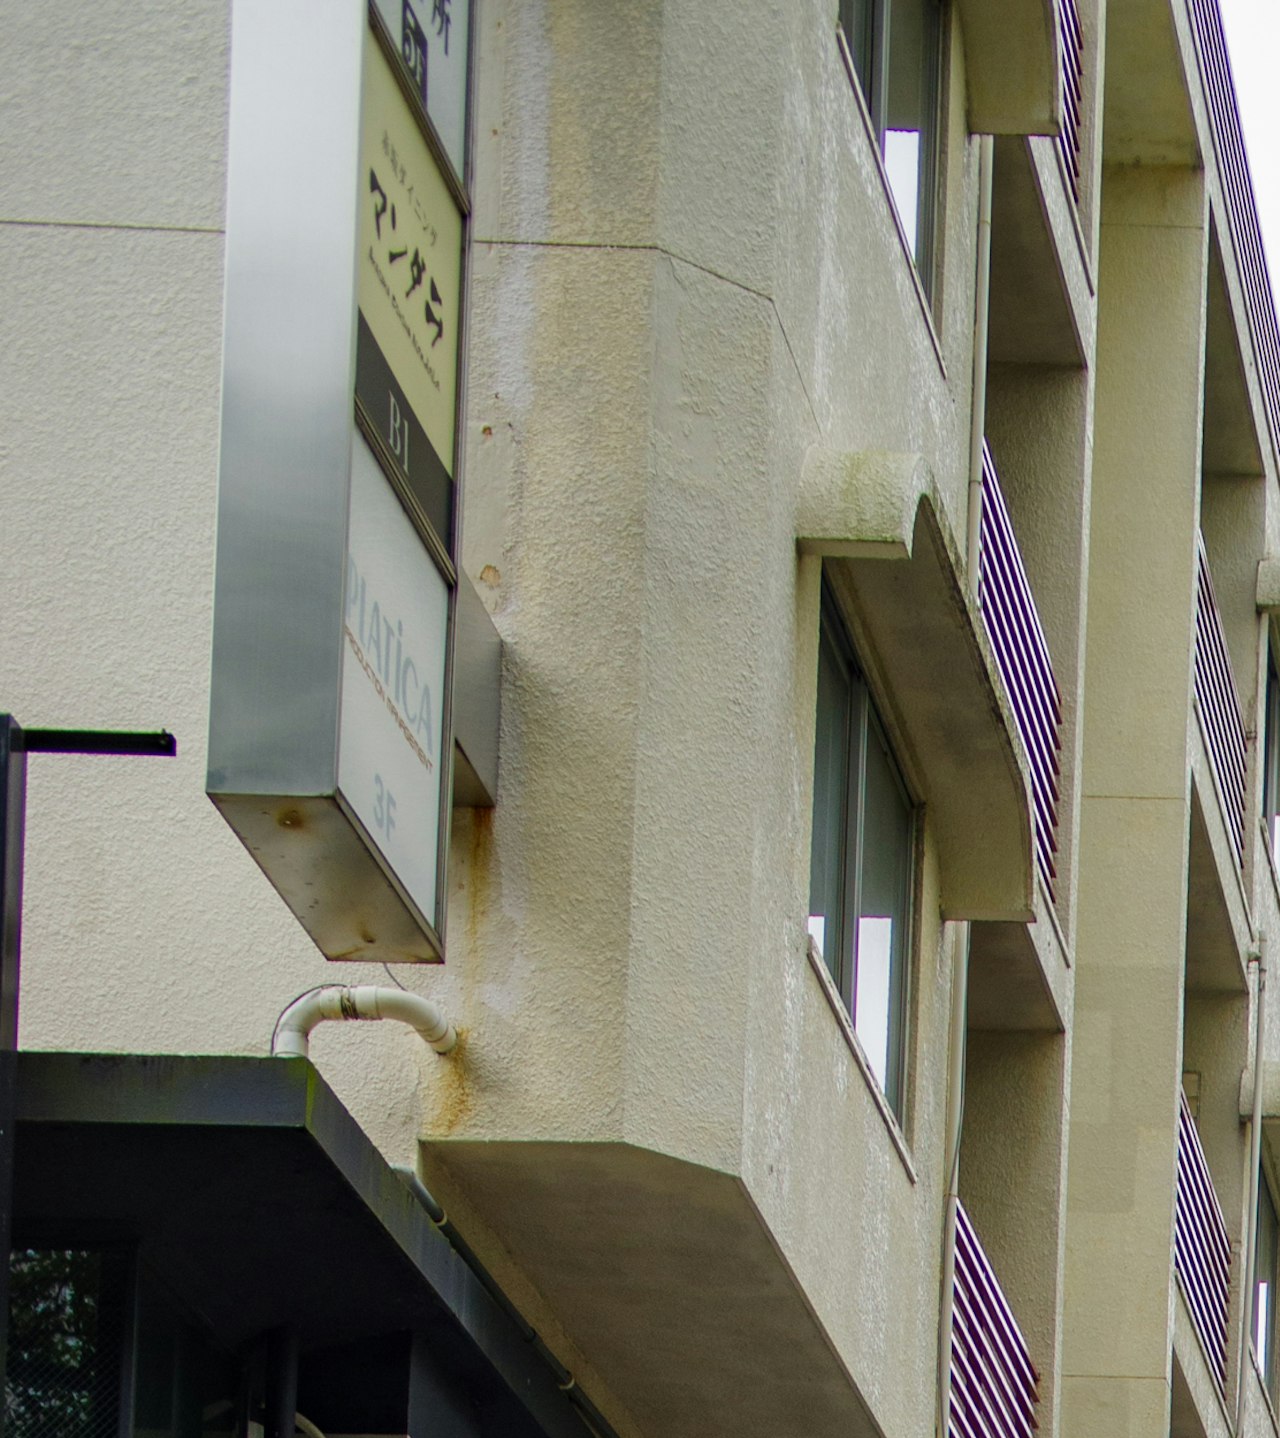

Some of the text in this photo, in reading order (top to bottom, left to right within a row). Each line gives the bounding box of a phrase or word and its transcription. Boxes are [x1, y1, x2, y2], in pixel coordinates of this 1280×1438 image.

[369, 165, 444, 350] マンダラ
[388, 389, 409, 477] B1
[373, 772, 397, 844] 3F
